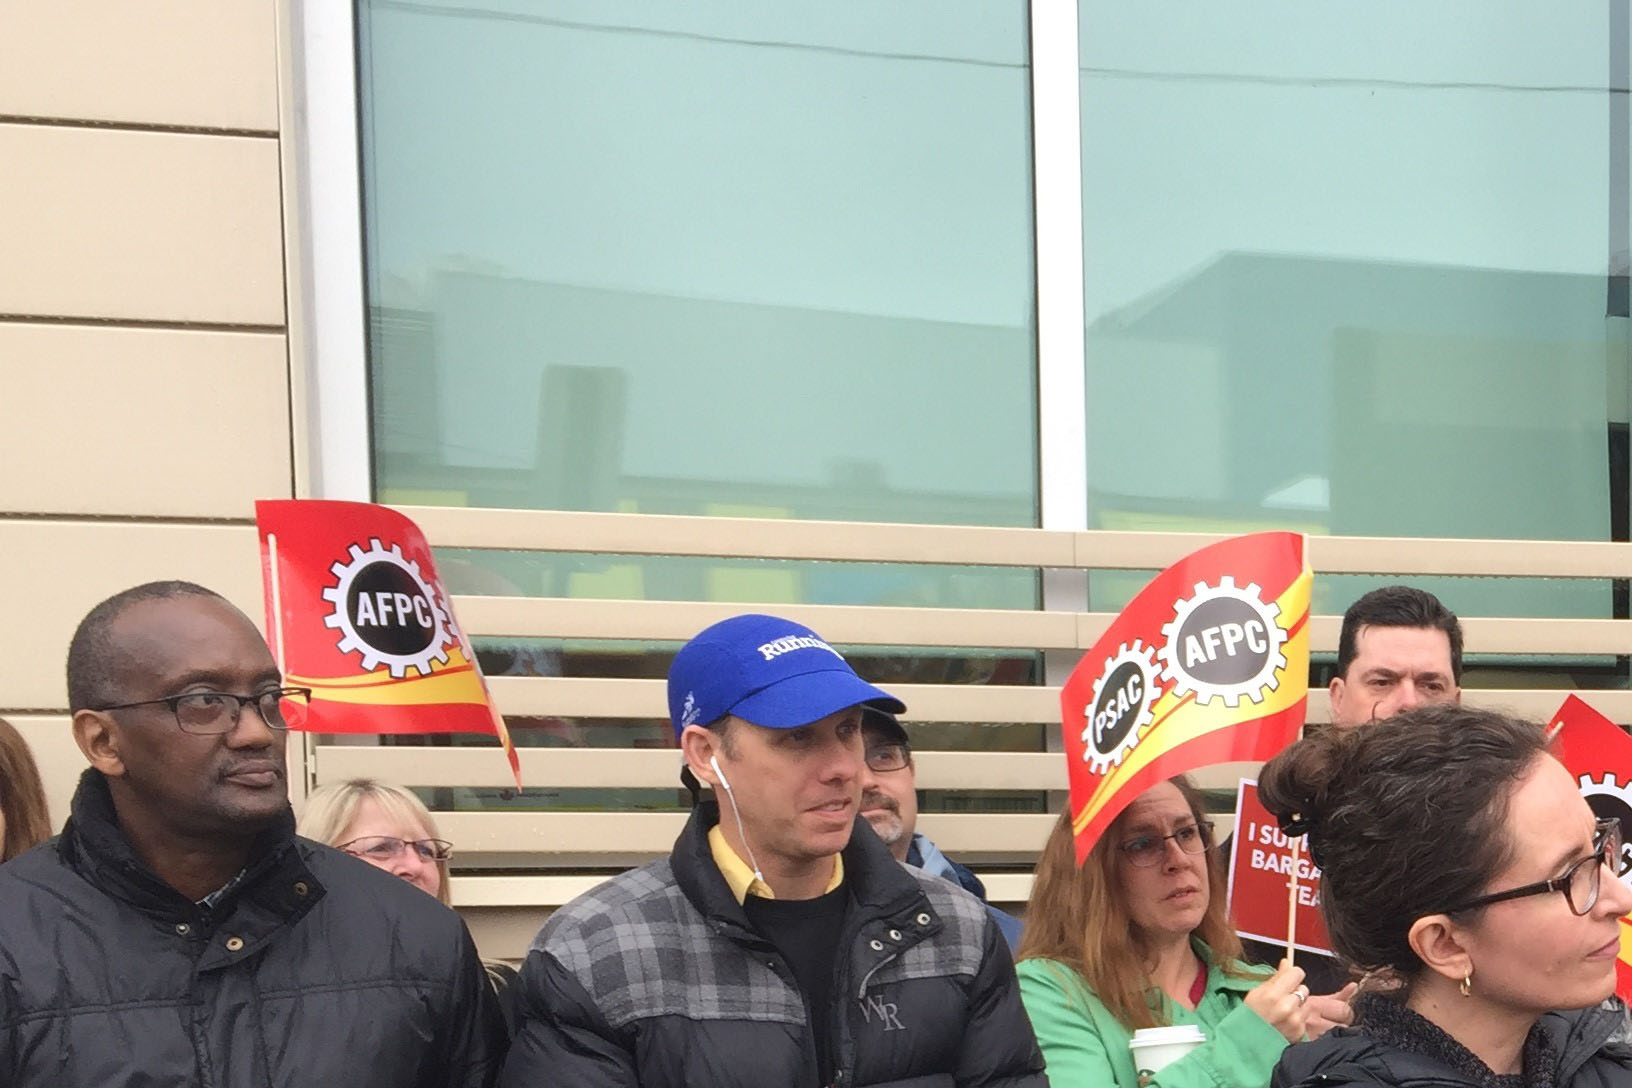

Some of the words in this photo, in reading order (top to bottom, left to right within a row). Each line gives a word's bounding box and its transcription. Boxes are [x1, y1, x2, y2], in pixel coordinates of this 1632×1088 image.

[356, 591, 432, 628] AFPC
[1095, 673, 1143, 743] PSAC
[1185, 619, 1267, 668] AFPC
[1251, 849, 1322, 880] BARGA
[1286, 882, 1321, 907] TEA
